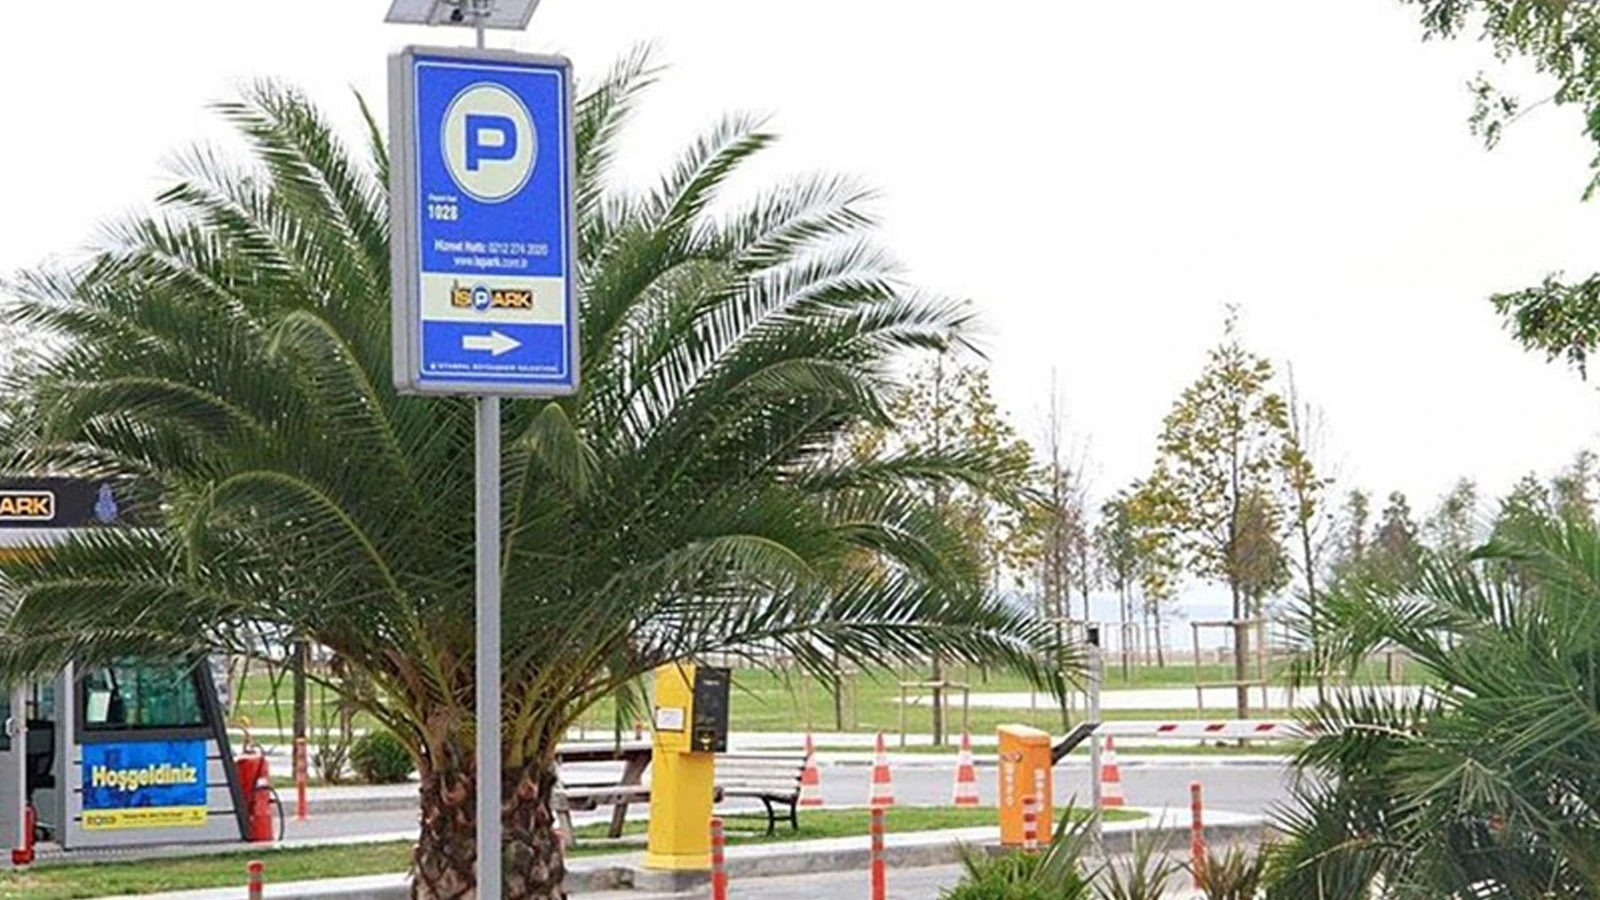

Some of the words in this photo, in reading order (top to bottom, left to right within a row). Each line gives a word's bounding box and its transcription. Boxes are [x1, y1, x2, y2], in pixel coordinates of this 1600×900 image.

[465, 114, 517, 171] P
[428, 204, 458, 220] 1028
[92, 762, 197, 792] Hoşgeldiniz
